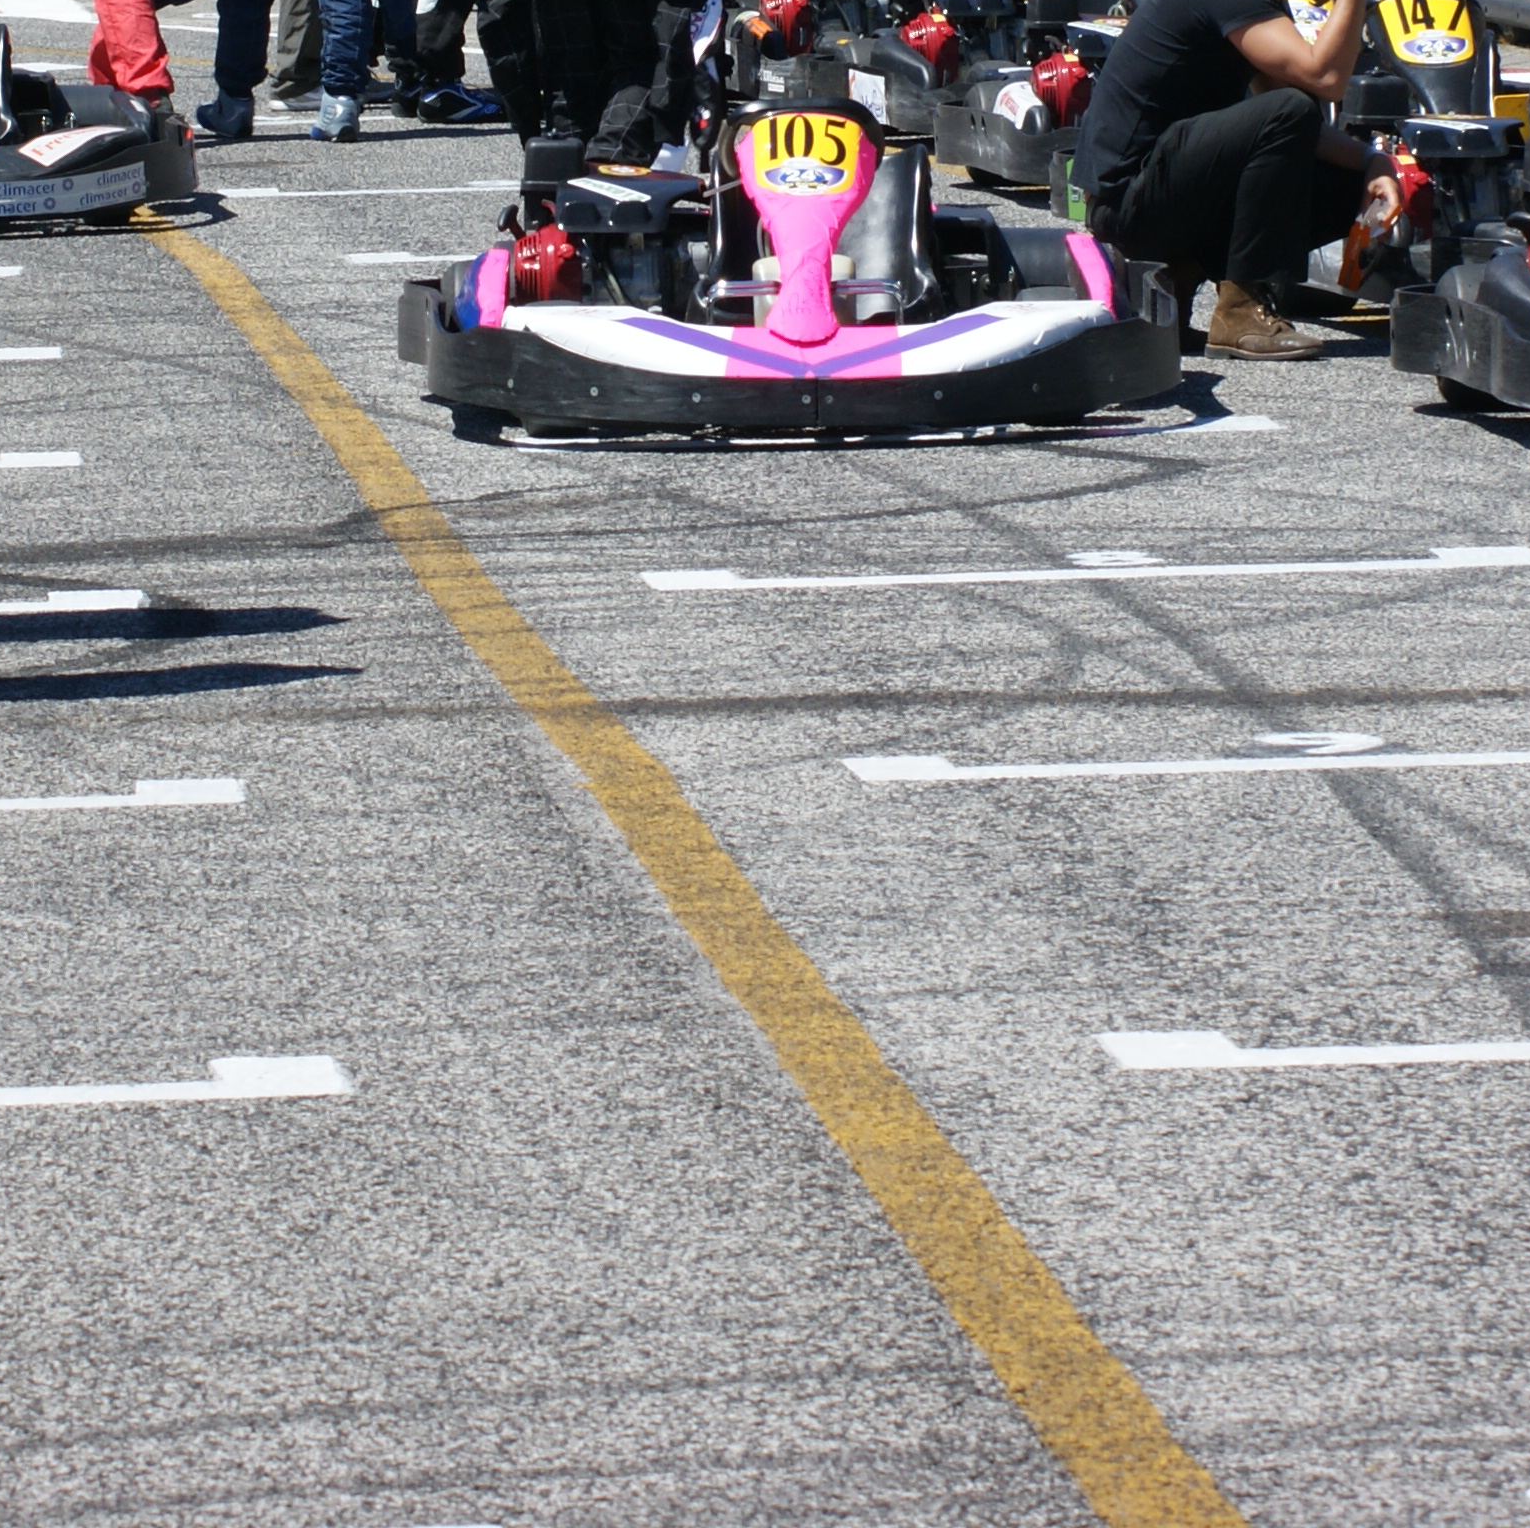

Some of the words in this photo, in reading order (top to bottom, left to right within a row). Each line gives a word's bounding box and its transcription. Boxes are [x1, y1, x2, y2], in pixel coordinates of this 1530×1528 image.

[768, 114, 847, 166] 105
[96, 166, 142, 187] climacer
[80, 186, 129, 207] climacer
